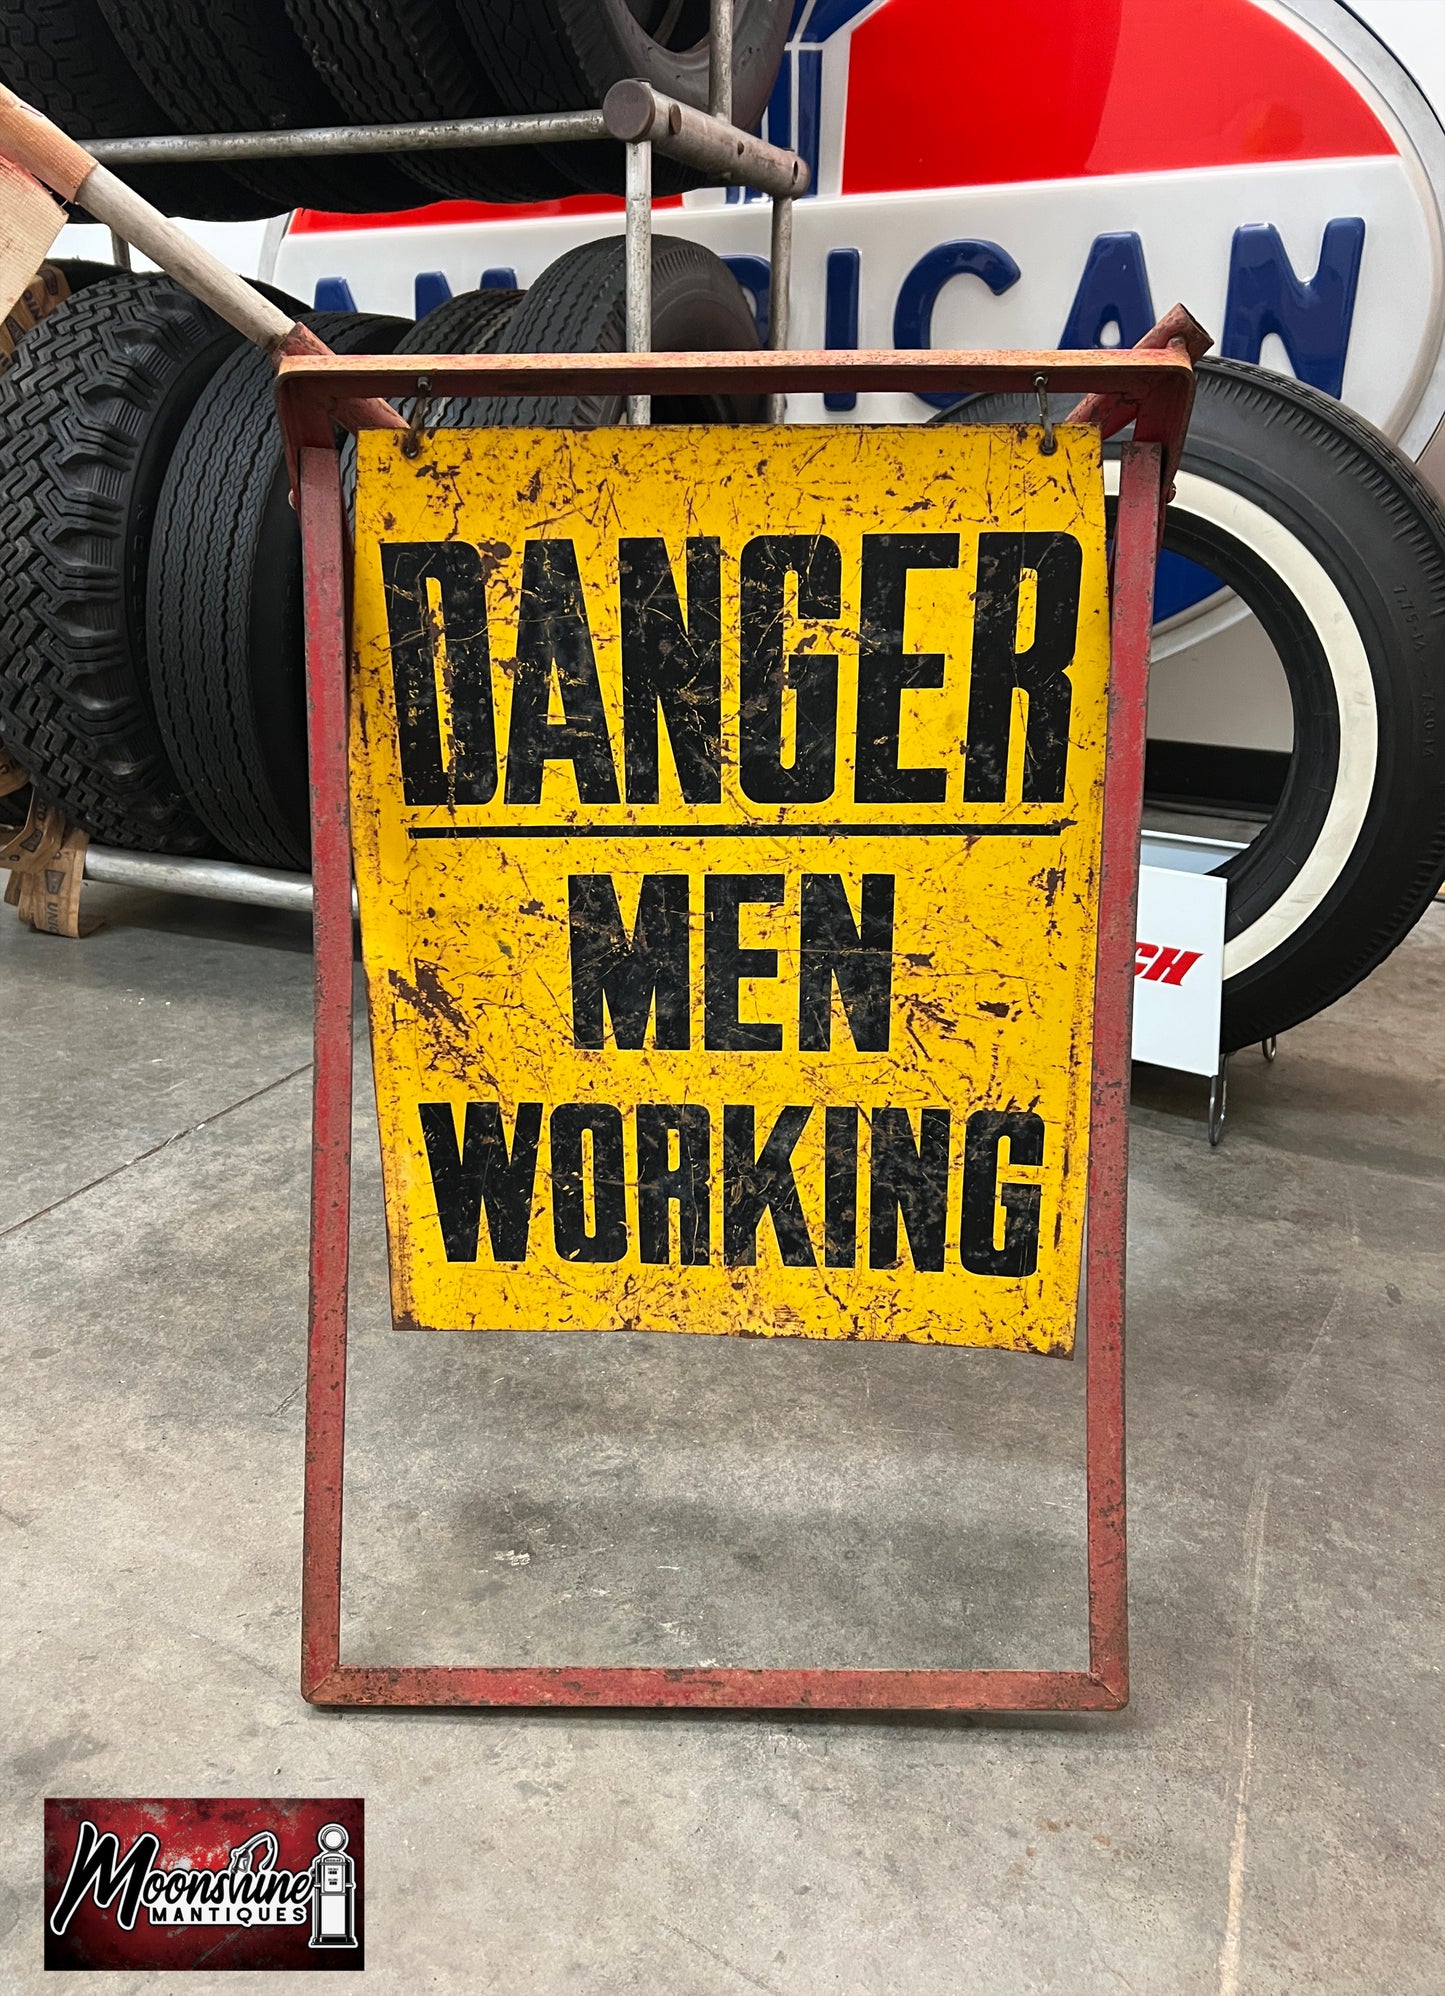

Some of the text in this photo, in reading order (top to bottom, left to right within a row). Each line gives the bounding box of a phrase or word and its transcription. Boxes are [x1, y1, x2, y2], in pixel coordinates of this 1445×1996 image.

[380, 532, 1082, 805] DANGER
[567, 873, 896, 1052] MEN
[420, 1102, 1045, 1277] WORKING
